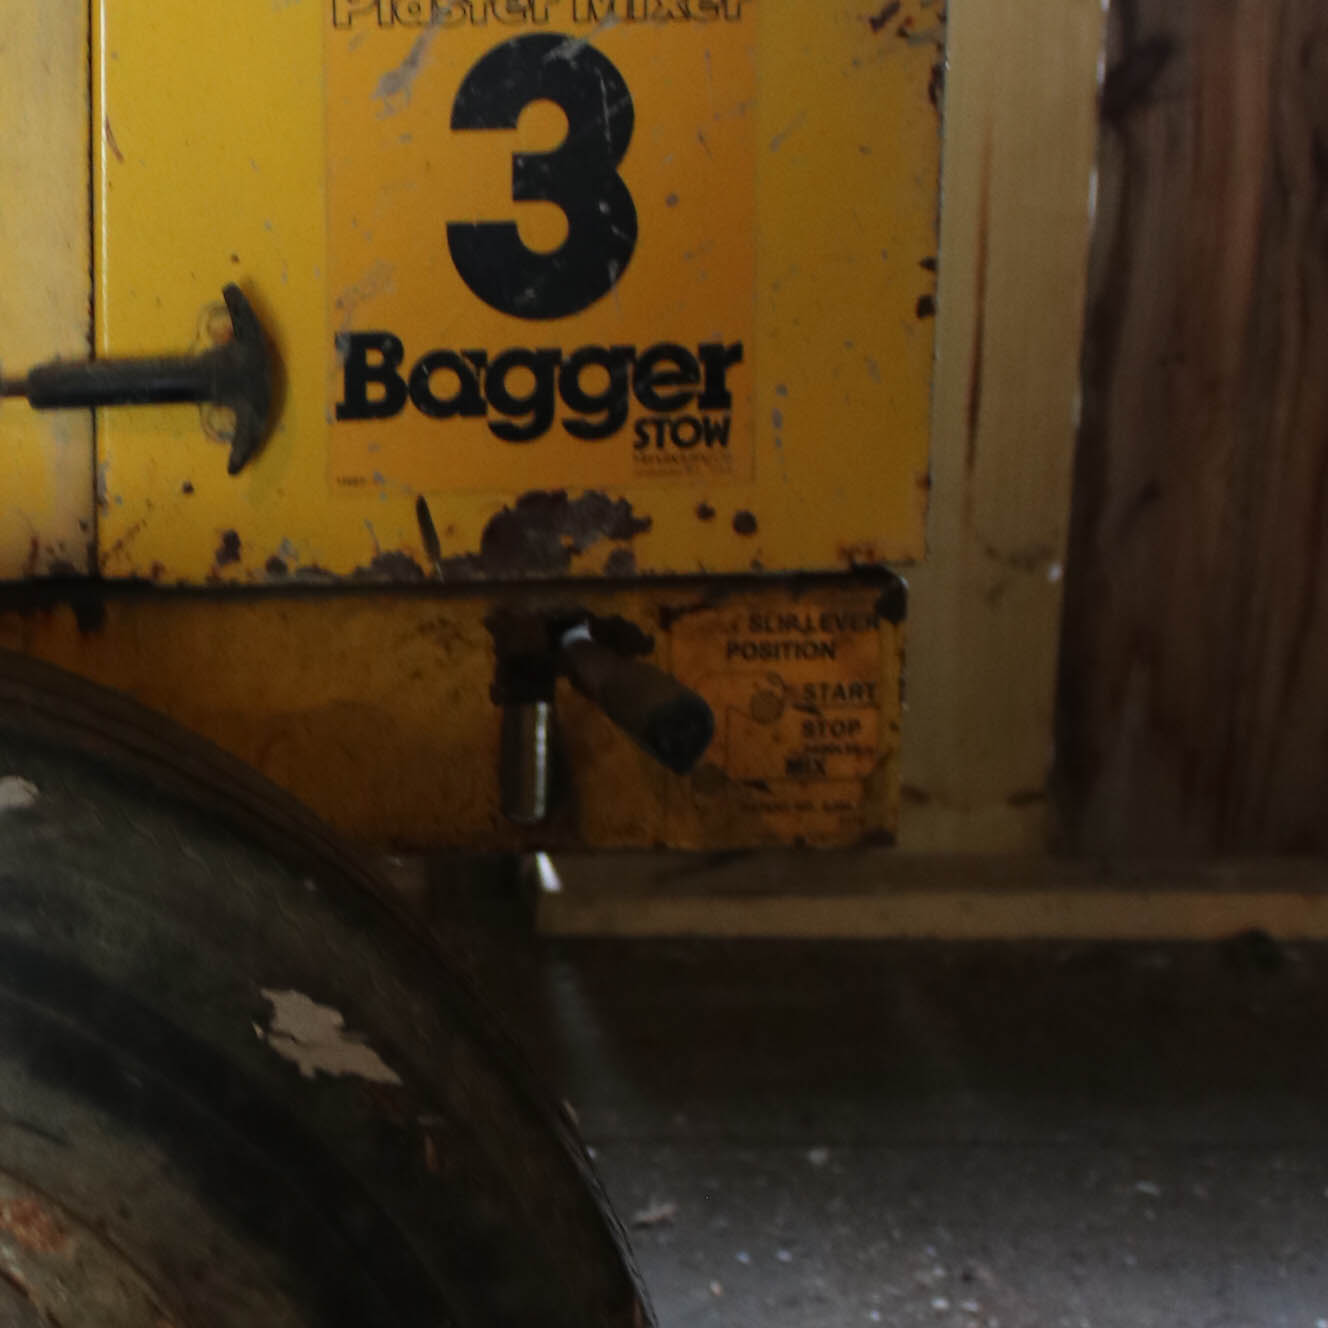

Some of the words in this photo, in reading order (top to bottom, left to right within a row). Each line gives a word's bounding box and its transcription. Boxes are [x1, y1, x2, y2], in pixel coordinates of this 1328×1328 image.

[446, 31, 638, 321] 3
[334, 330, 744, 443] Bagger
[633, 415, 731, 449] STOW
[726, 640, 837, 661] POSITION
[802, 682, 877, 702] START
[801, 718, 862, 738] STOP
